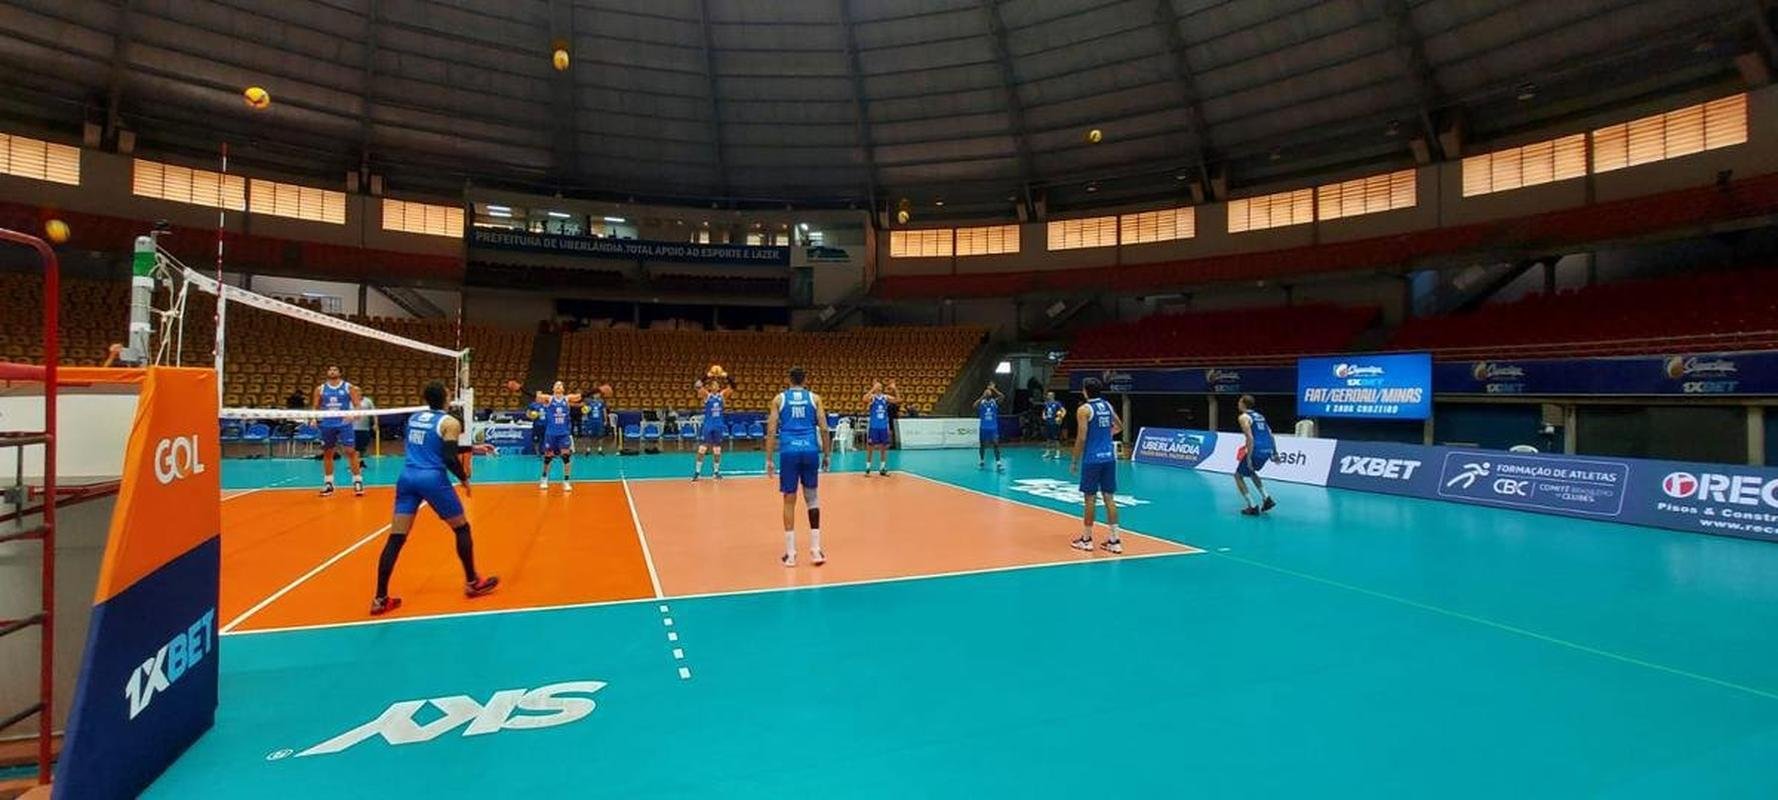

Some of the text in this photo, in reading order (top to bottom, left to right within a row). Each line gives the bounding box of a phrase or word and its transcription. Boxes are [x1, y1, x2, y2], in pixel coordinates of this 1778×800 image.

[475, 231, 541, 248] PREFEITURA
[544, 237, 558, 249] DE
[700, 248, 742, 259] ESPORTE
[154, 434, 205, 484] GOL
[1340, 455, 1422, 481] 1XBET
[1496, 464, 1618, 483] FORMAÇÃO DE ATLETAS
[1493, 478, 1529, 497] CBC
[1657, 502, 1698, 514] Pisos
[1703, 507, 1715, 516] &
[125, 608, 215, 720] 1XBET
[293, 680, 608, 757] SKY
